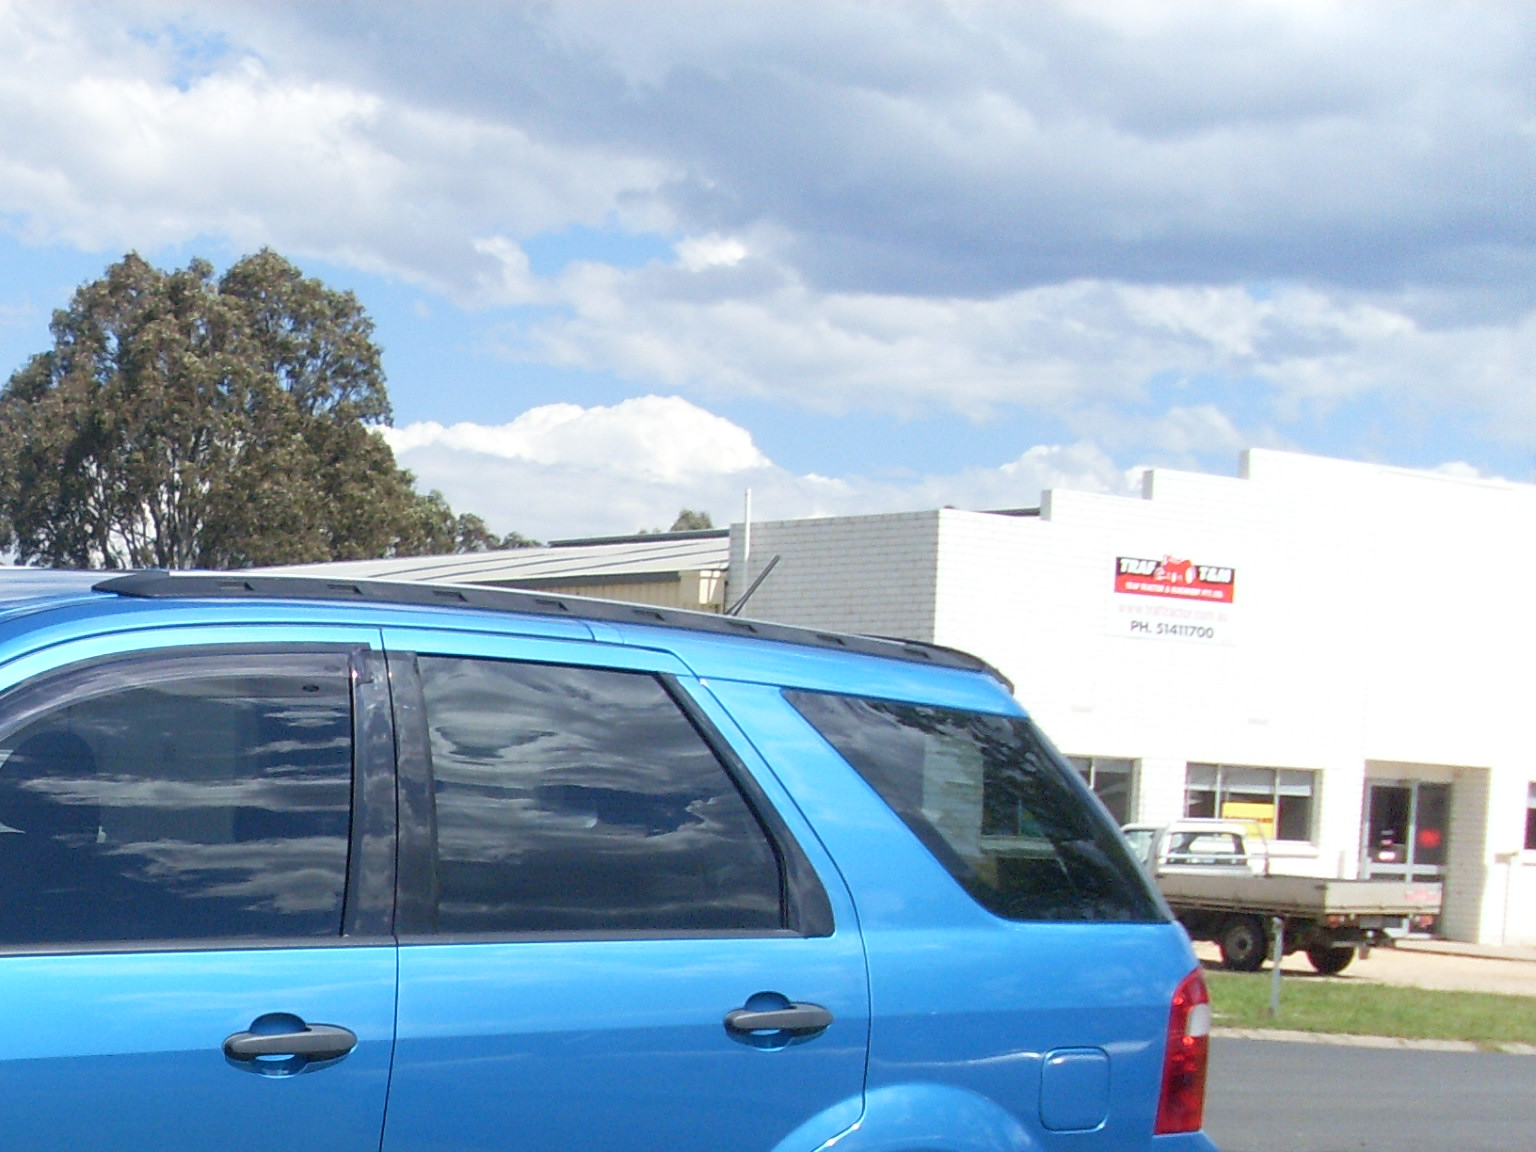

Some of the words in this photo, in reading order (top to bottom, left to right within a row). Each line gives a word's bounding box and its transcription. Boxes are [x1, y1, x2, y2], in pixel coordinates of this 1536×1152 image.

[1120, 558, 1157, 575] TRAF
[1199, 567, 1232, 583] T&M
[1130, 620, 1152, 633] PH.
[1156, 623, 1214, 639] 51411700
